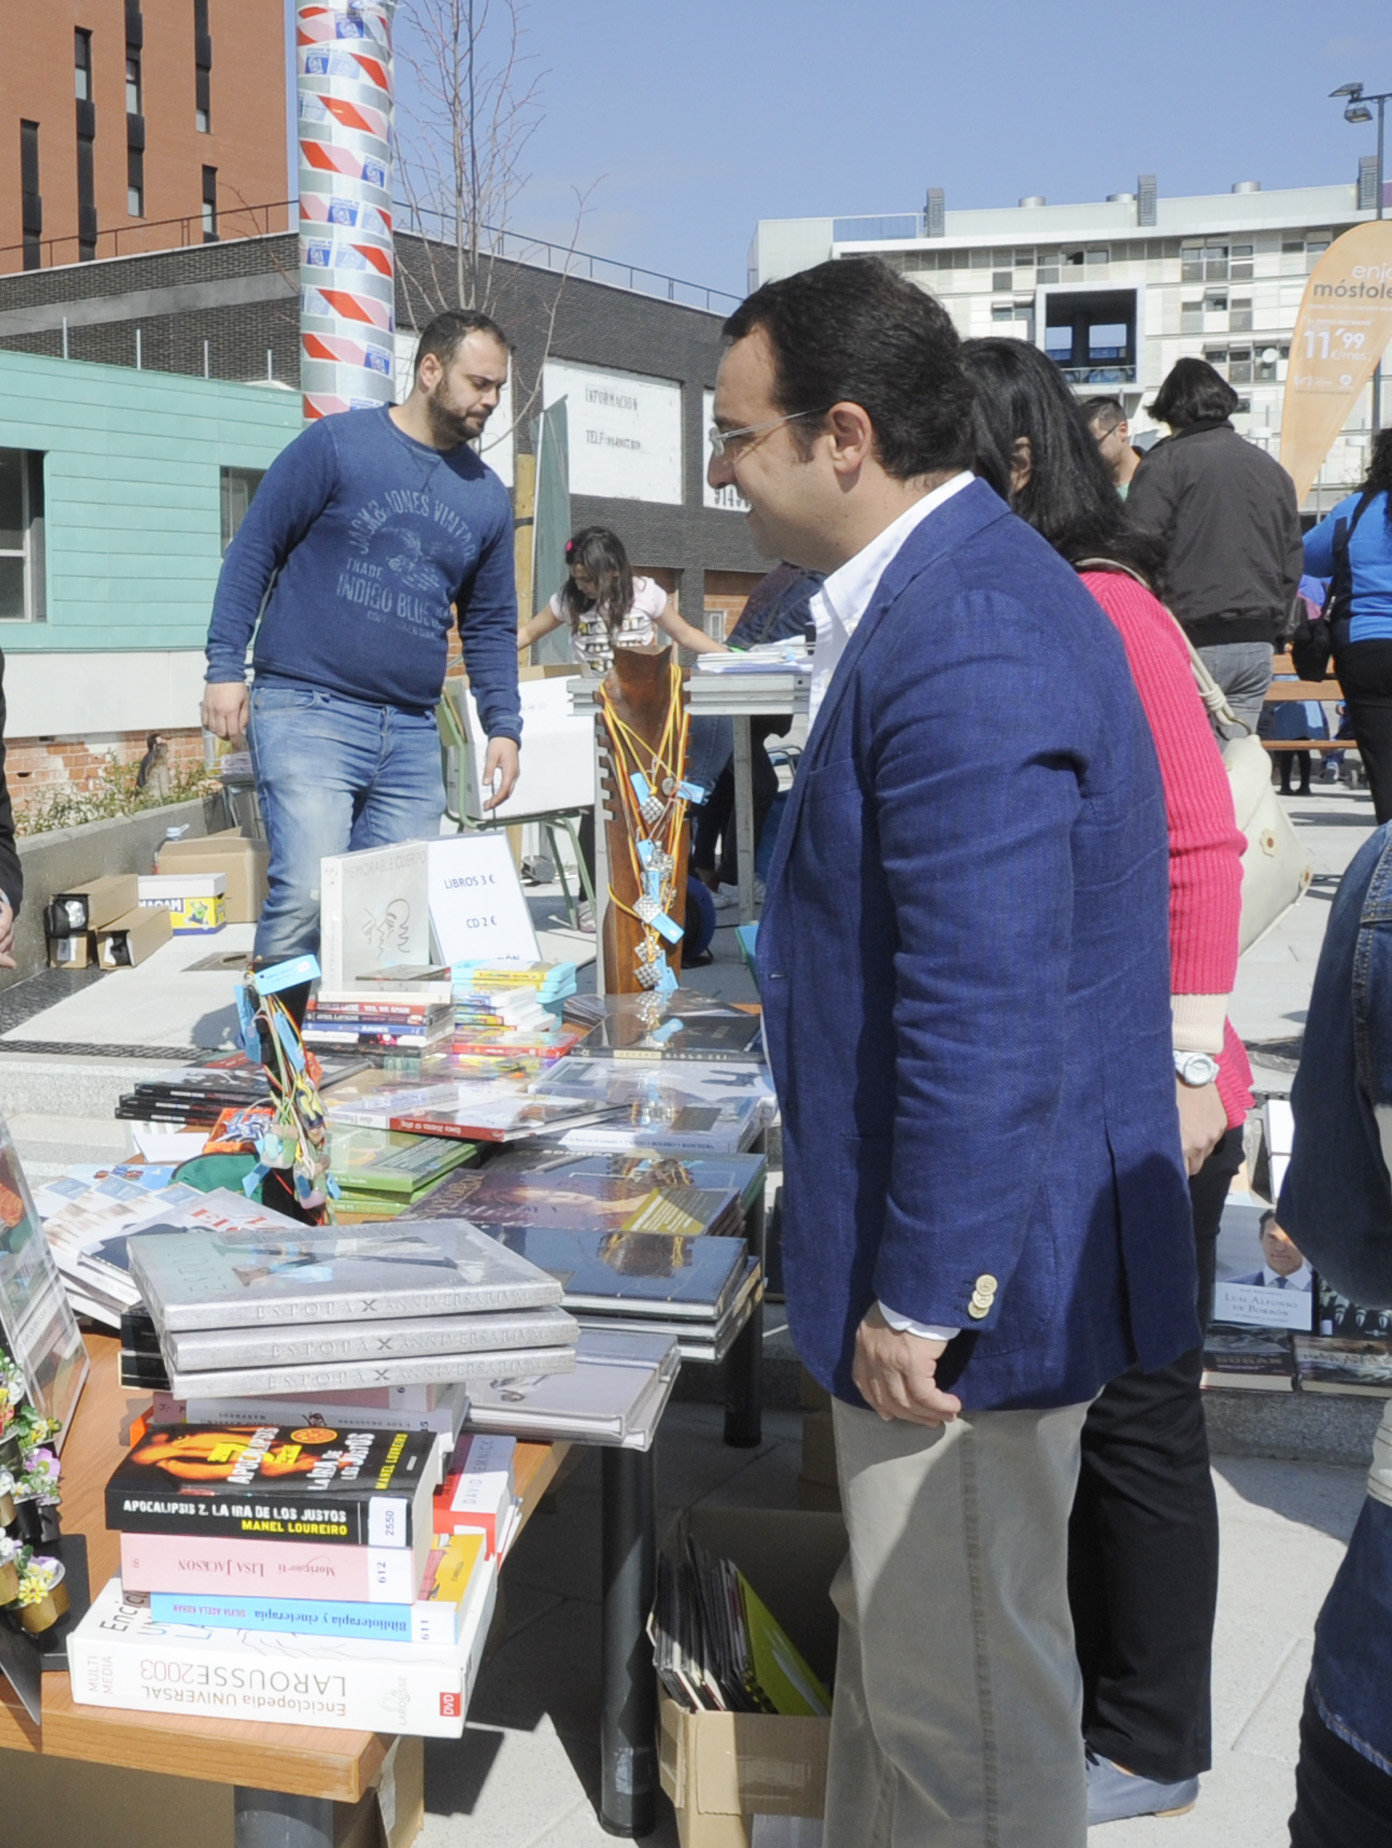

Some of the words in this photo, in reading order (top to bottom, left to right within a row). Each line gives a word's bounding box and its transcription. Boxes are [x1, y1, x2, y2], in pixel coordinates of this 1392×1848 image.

[384, 489, 429, 517] JONES
[336, 573, 392, 613] INDIGO
[444, 876, 478, 889] LIBROS
[481, 875, 487, 884] 3
[489, 874, 495, 884] €
[466, 918, 480, 929] CD
[483, 917, 488, 926] 2
[491, 916, 498, 926] €
[463, 1479, 482, 1504] DAVID
[123, 1500, 195, 1515] APOCALIPSIS
[212, 1505, 229, 1517] LA
[232, 1506, 253, 1518] IRA
[256, 1506, 271, 1519] DE
[274, 1507, 298, 1520] LOS
[301, 1508, 347, 1522] JUSTOS
[242, 1520, 285, 1534] MANEL
[288, 1521, 348, 1536] LOUREIRO
[385, 1510, 395, 1536] 2550
[178, 1560, 232, 1576] JACKSON
[237, 1562, 264, 1577] LISA
[377, 1561, 387, 1584] 612
[254, 1609, 318, 1625] cineterapia
[328, 1612, 407, 1632] Biblioterapia
[421, 1619, 429, 1640] 611
[87, 1655, 99, 1692] MULTI
[102, 1656, 113, 1694] MEDIA
[141, 1685, 237, 1707] UNIVERSAL
[243, 1695, 346, 1717] Enciclopedia
[444, 1694, 455, 1715] DVD
